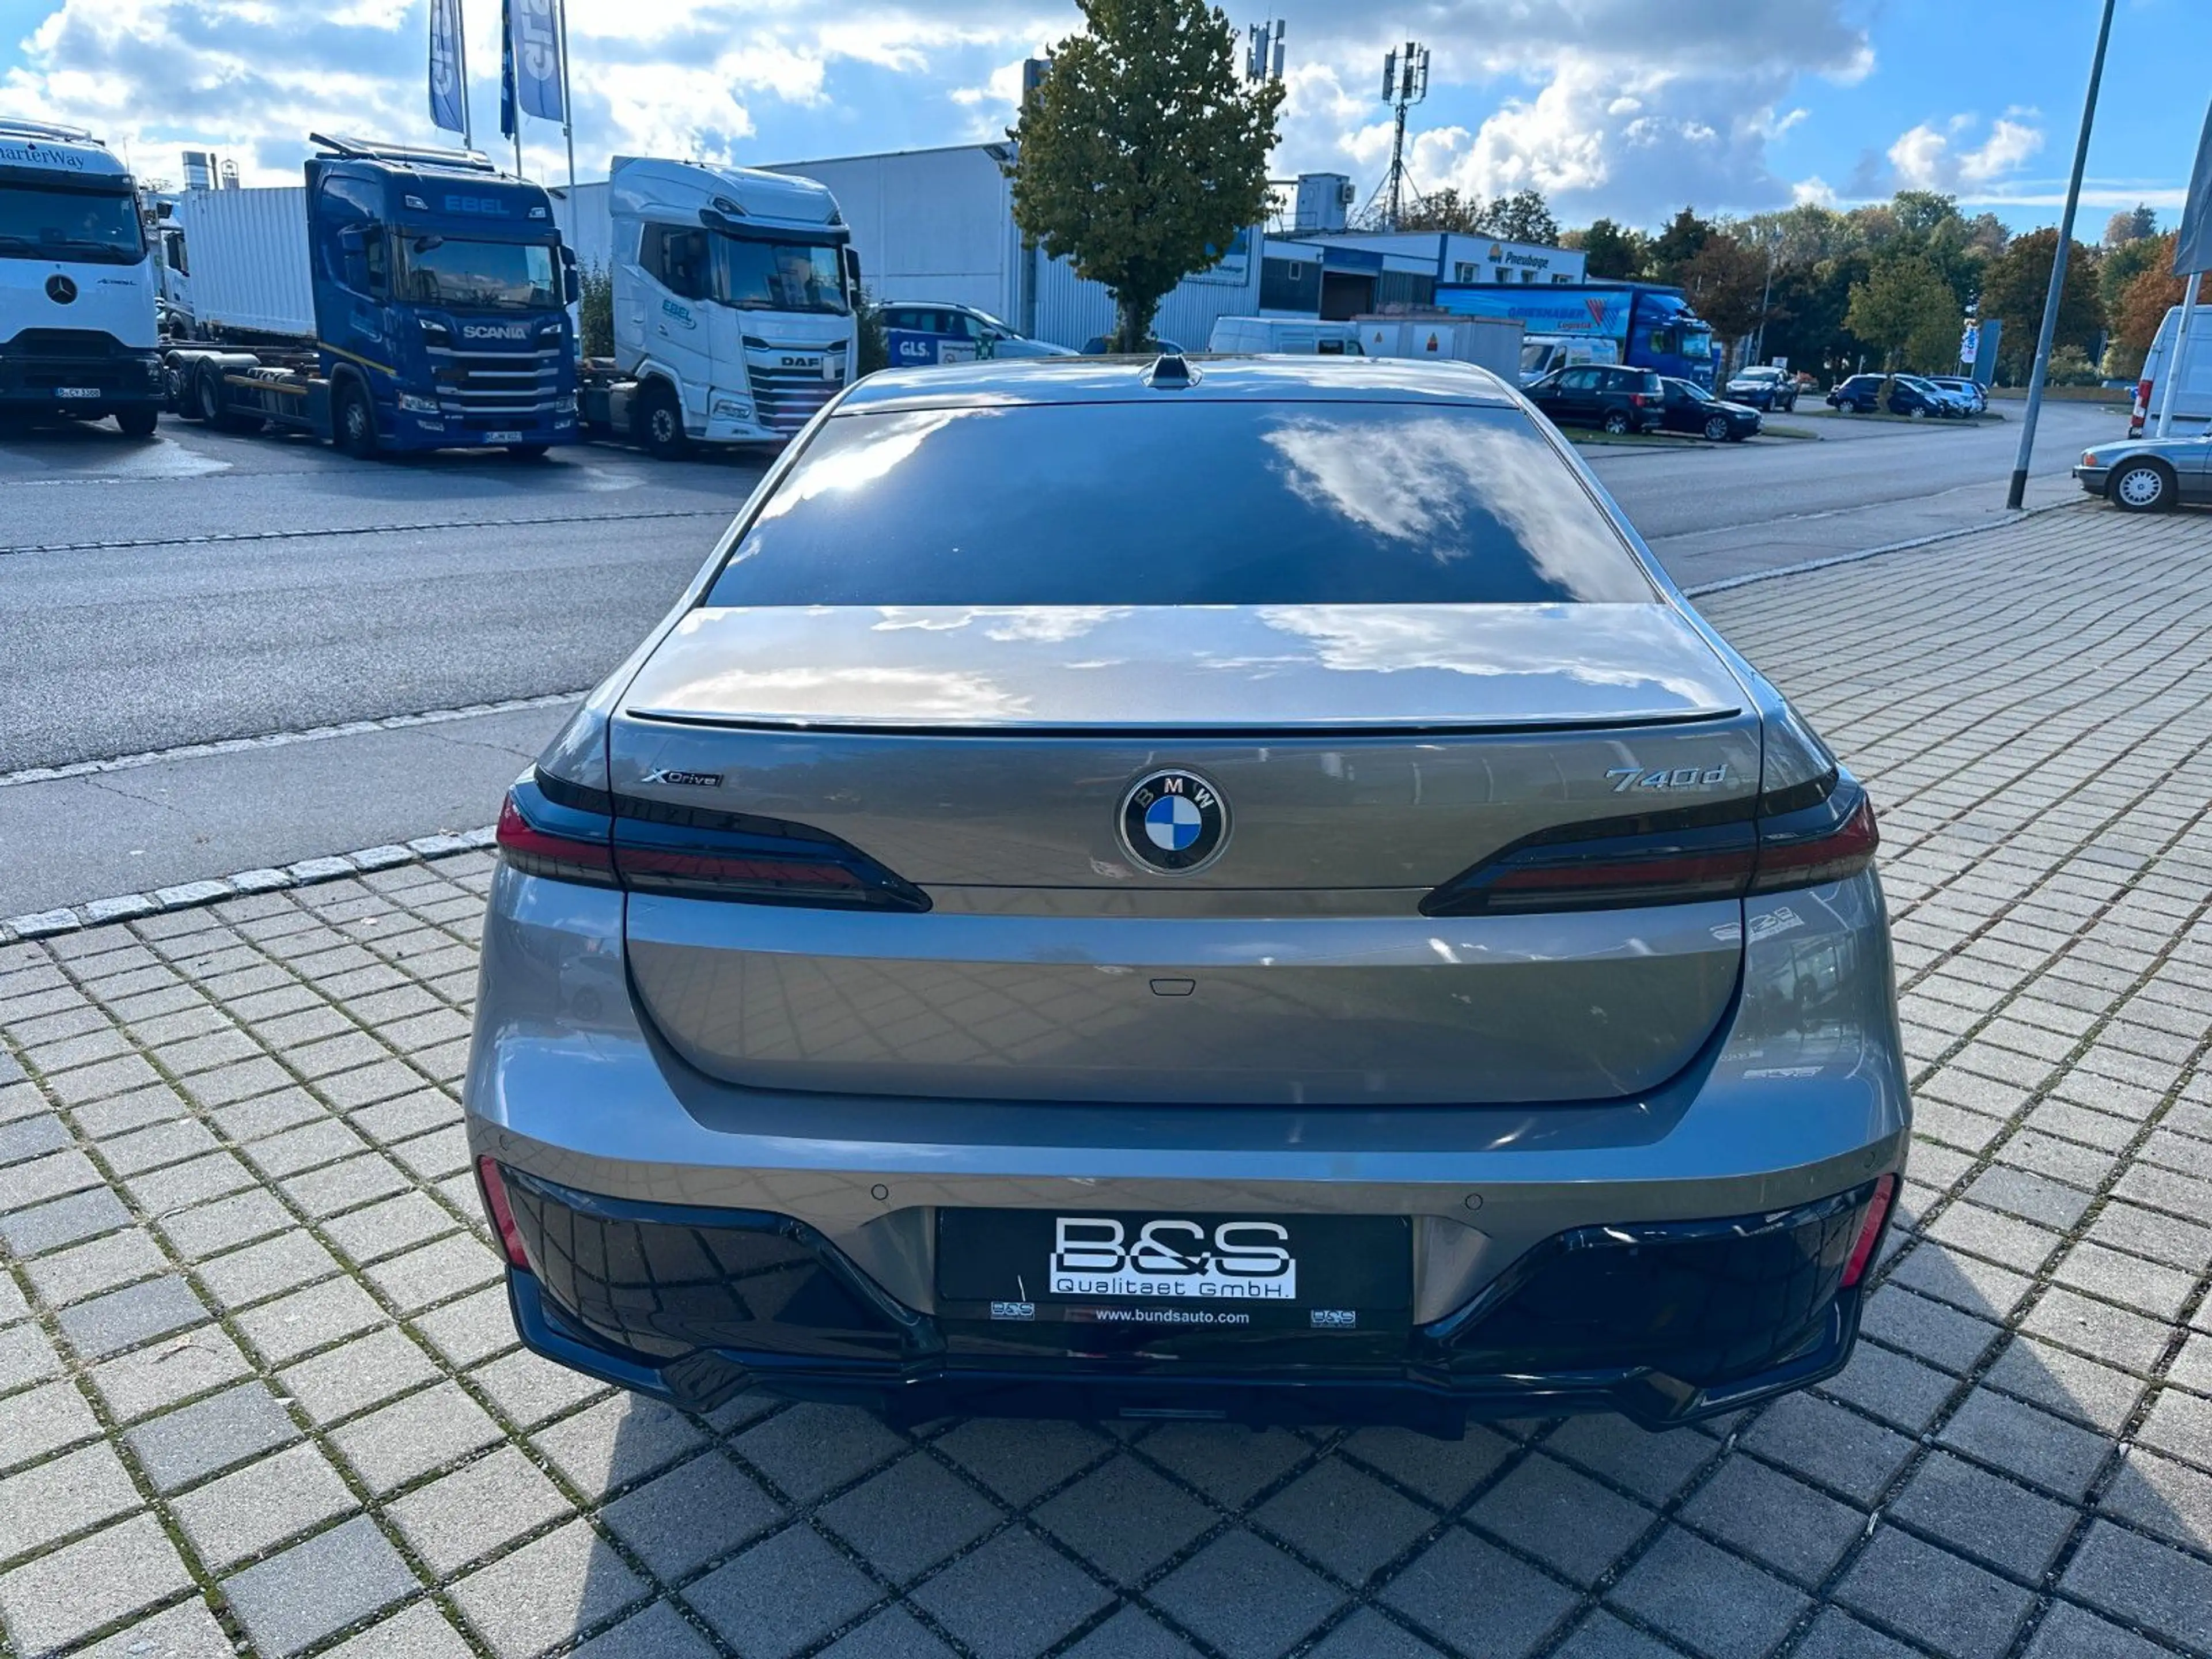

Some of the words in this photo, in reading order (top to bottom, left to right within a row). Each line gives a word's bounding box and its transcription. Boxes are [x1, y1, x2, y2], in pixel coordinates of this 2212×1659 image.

[444, 195, 510, 214] EBEL
[662, 299, 692, 322] EBEL
[463, 325, 527, 339] SCANIA
[781, 357, 820, 367] DAF
[1605, 763, 1728, 793] 740d
[1134, 778, 1215, 808] BMW
[1056, 1217, 1290, 1277] B&S
[1056, 1277, 1186, 1296] Qualitaet
[1096, 1308, 1250, 1324] www.bundsauto.com
